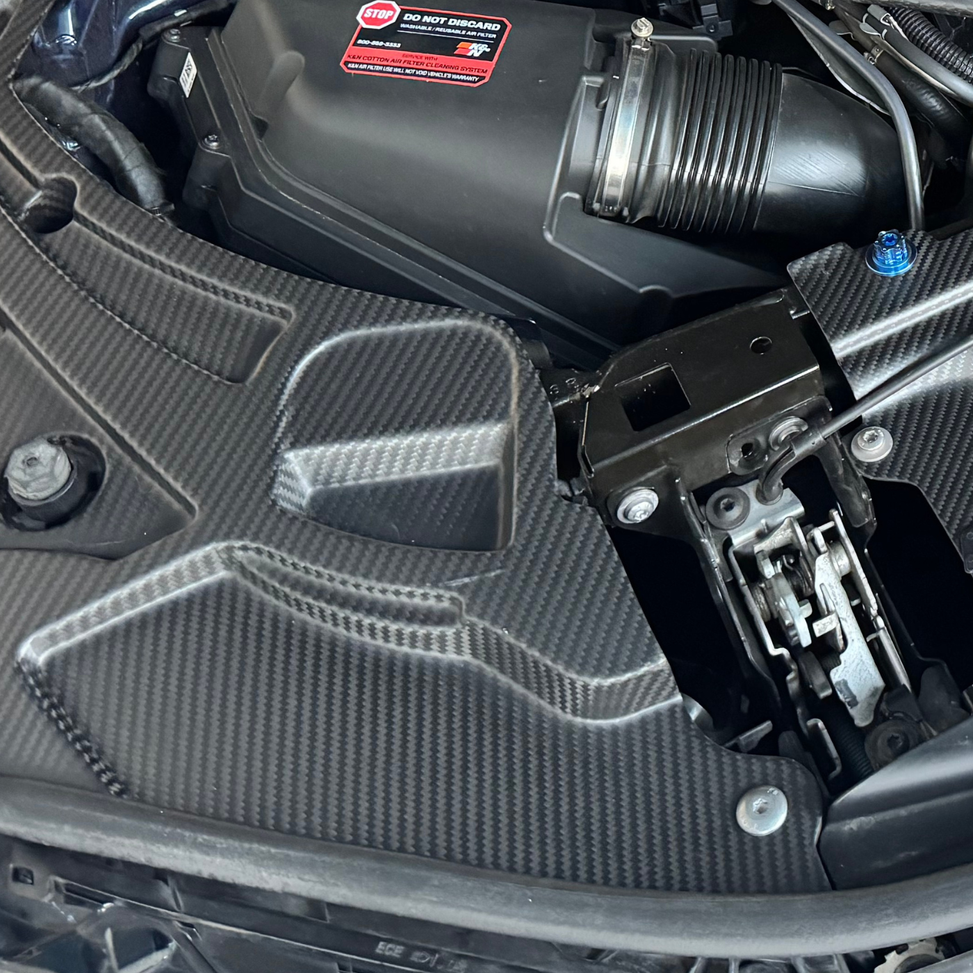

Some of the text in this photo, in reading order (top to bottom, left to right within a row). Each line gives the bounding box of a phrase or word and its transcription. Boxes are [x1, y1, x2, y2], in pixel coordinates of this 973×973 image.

[364, 8, 394, 19] STOP
[403, 13, 501, 31] DO NOT DISCARD
[467, 42, 491, 57] K&N
[362, 55, 390, 63] COTTON
[402, 59, 425, 67] FILTER
[425, 62, 460, 71] CLEANING
[460, 65, 488, 74] SYSTEM
[451, 73, 480, 82] WARRANTY
